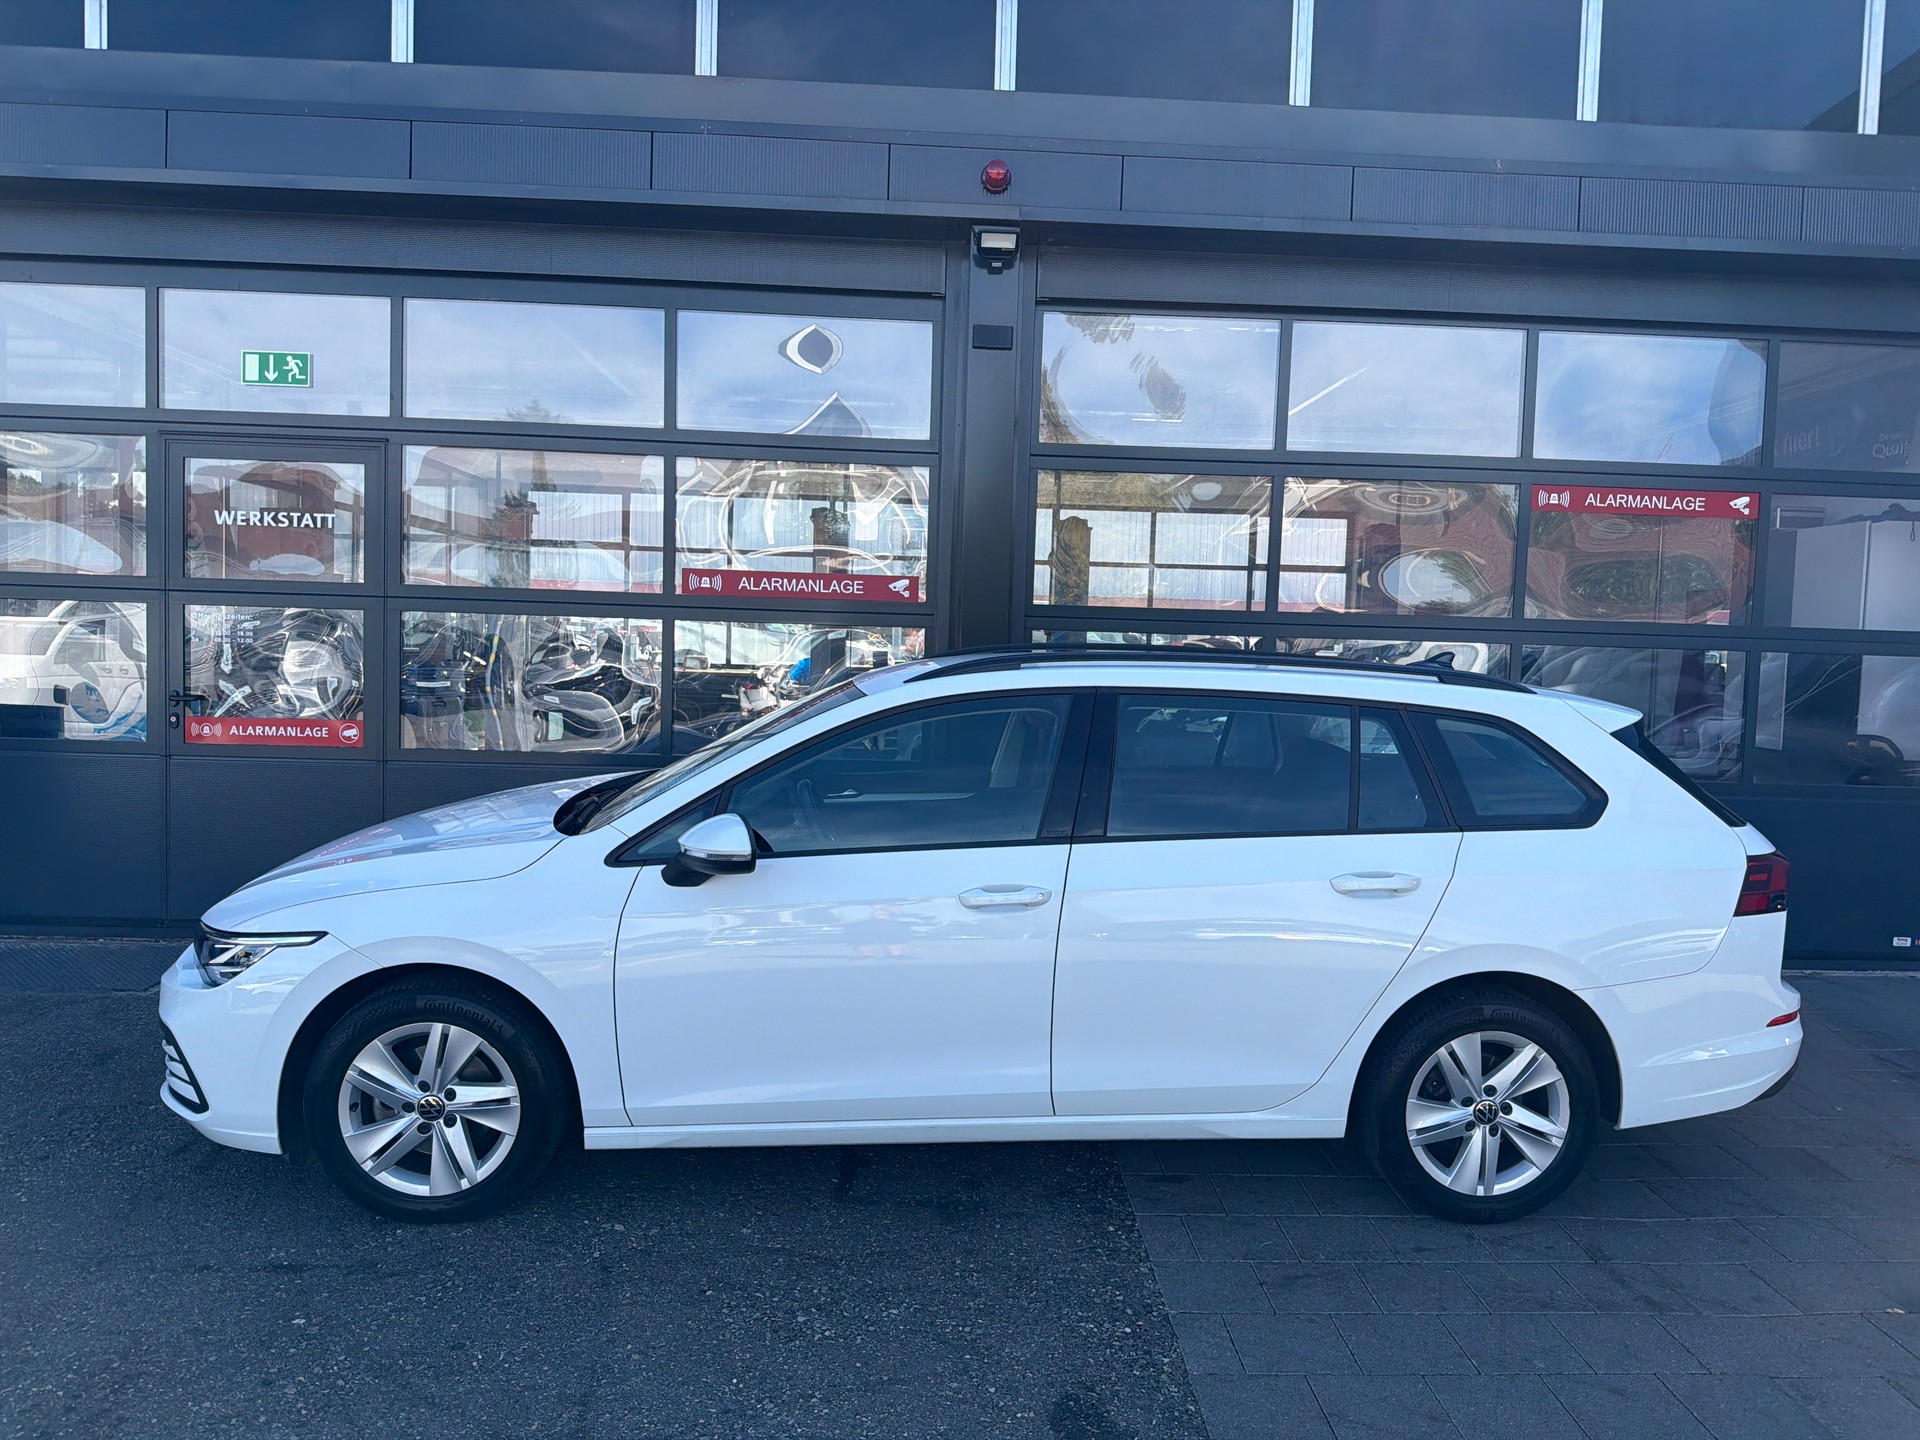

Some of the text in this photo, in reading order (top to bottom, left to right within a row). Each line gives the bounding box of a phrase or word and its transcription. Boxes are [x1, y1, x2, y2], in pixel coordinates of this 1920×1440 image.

[1585, 492, 1706, 511] ALARMANLAGE
[214, 510, 335, 529] WERKSTATT
[738, 576, 864, 594] ALARMANLAGE
[229, 725, 329, 738] ALARMANLAGE
[423, 1000, 497, 1028] Continental
